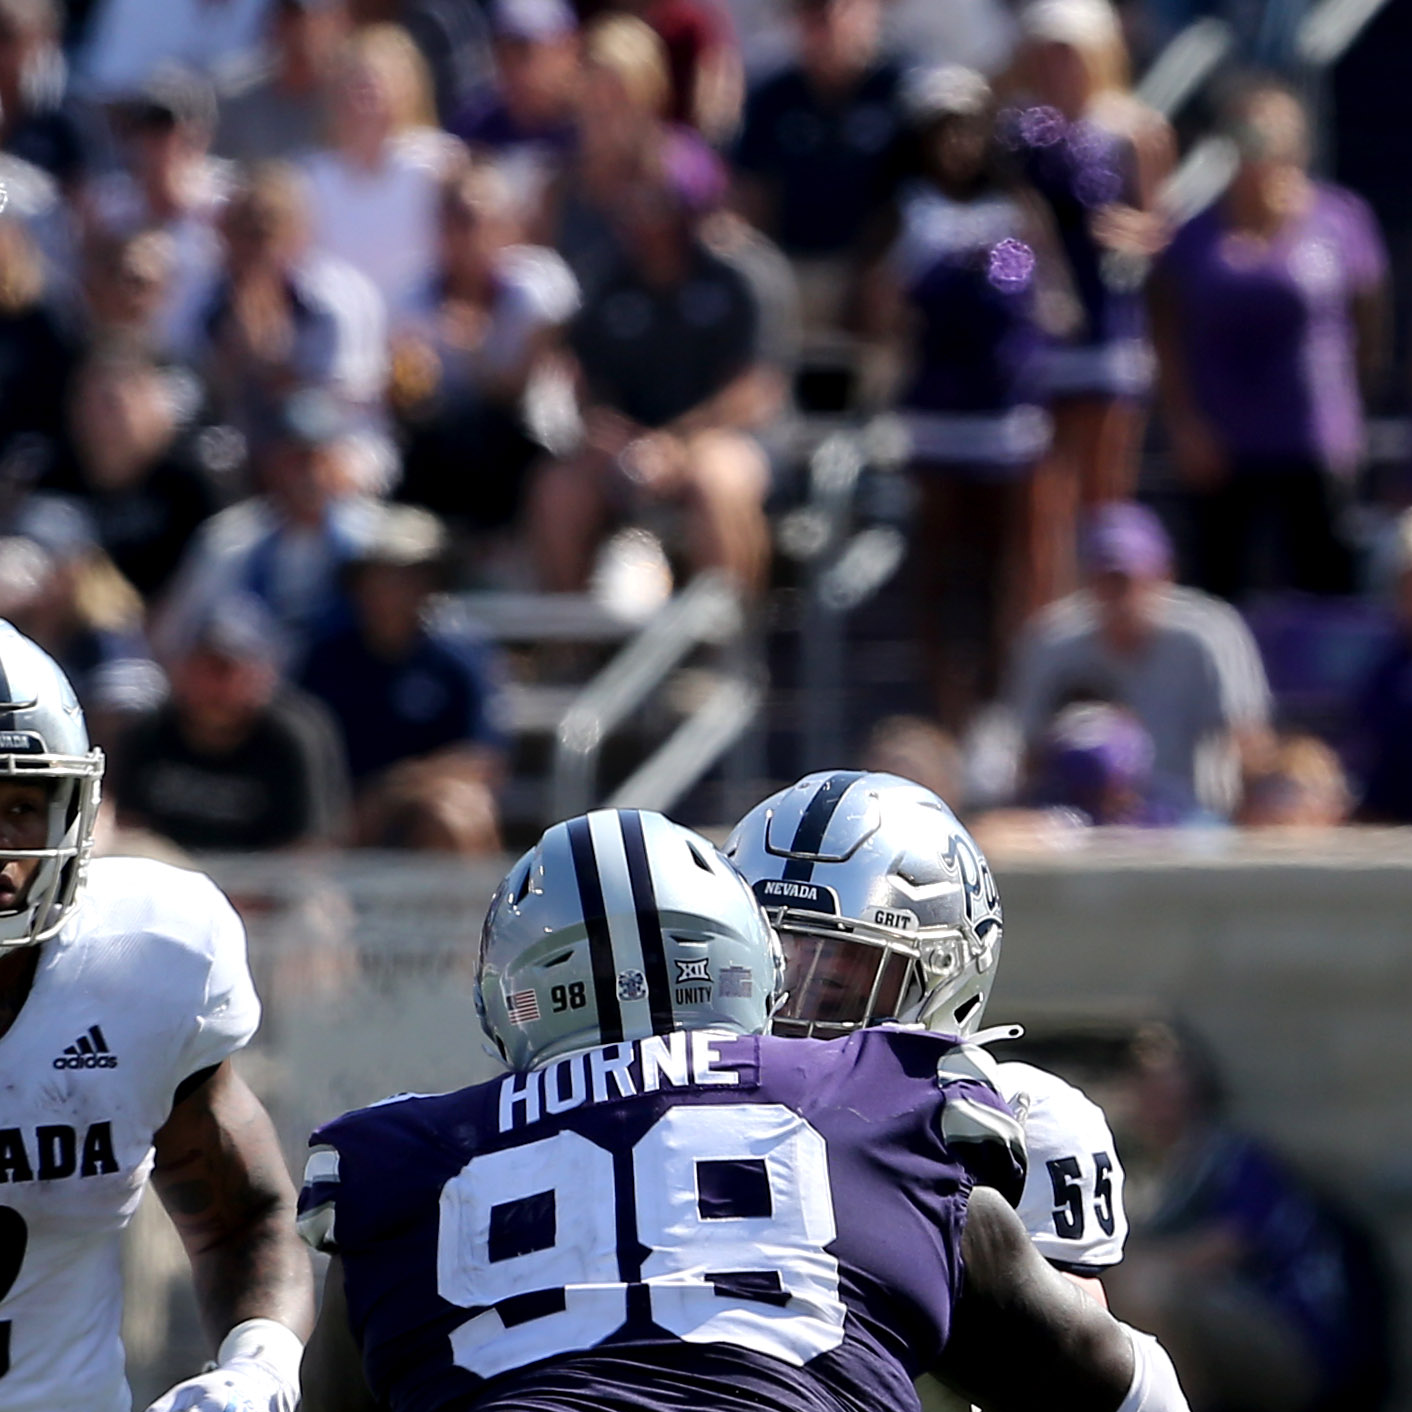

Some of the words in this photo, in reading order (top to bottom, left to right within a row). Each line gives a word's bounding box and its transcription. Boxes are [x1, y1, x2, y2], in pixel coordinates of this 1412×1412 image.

[764, 880, 818, 901] NEVADA
[874, 910, 911, 930] GRIT
[551, 981, 587, 1013] 98
[675, 987, 712, 1005] UNITY
[53, 1056, 118, 1070] adidas
[499, 1030, 739, 1133] HORNE
[1045, 1151, 1115, 1240] 55
[437, 1103, 846, 1378] 98
